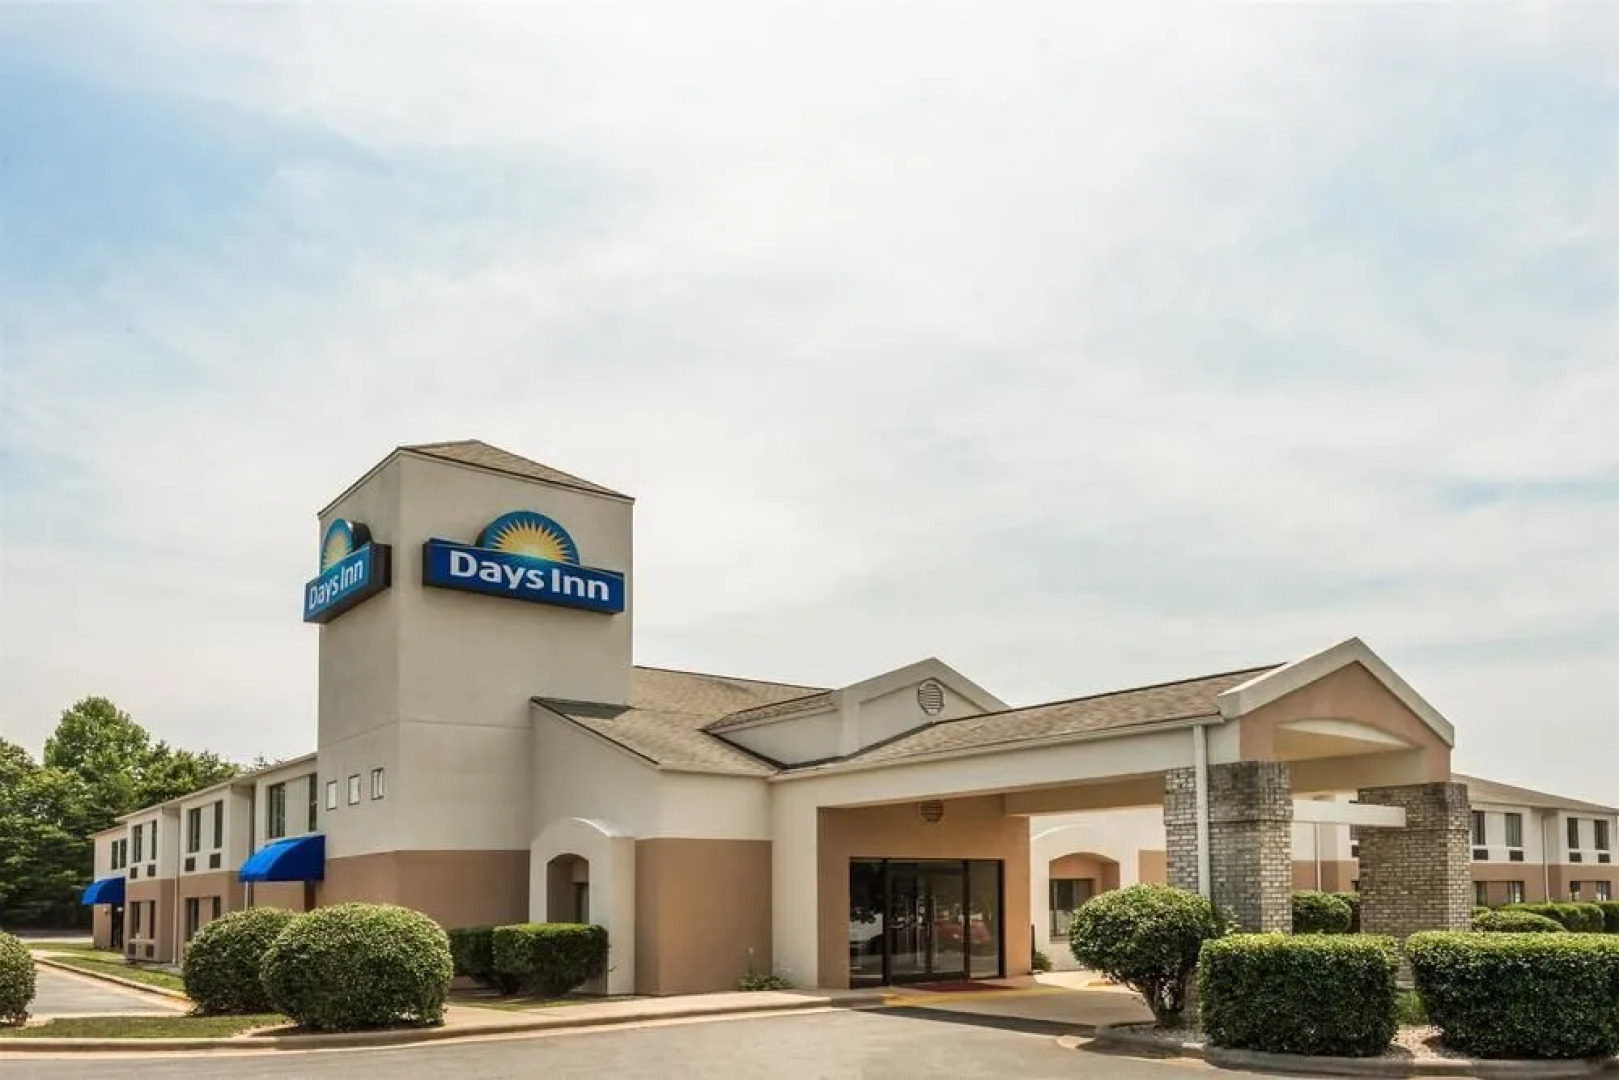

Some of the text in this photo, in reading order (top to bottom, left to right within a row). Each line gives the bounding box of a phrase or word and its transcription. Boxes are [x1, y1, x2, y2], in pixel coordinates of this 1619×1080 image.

[308, 559, 363, 609] Days Inn
[450, 550, 609, 601] Days Inn
